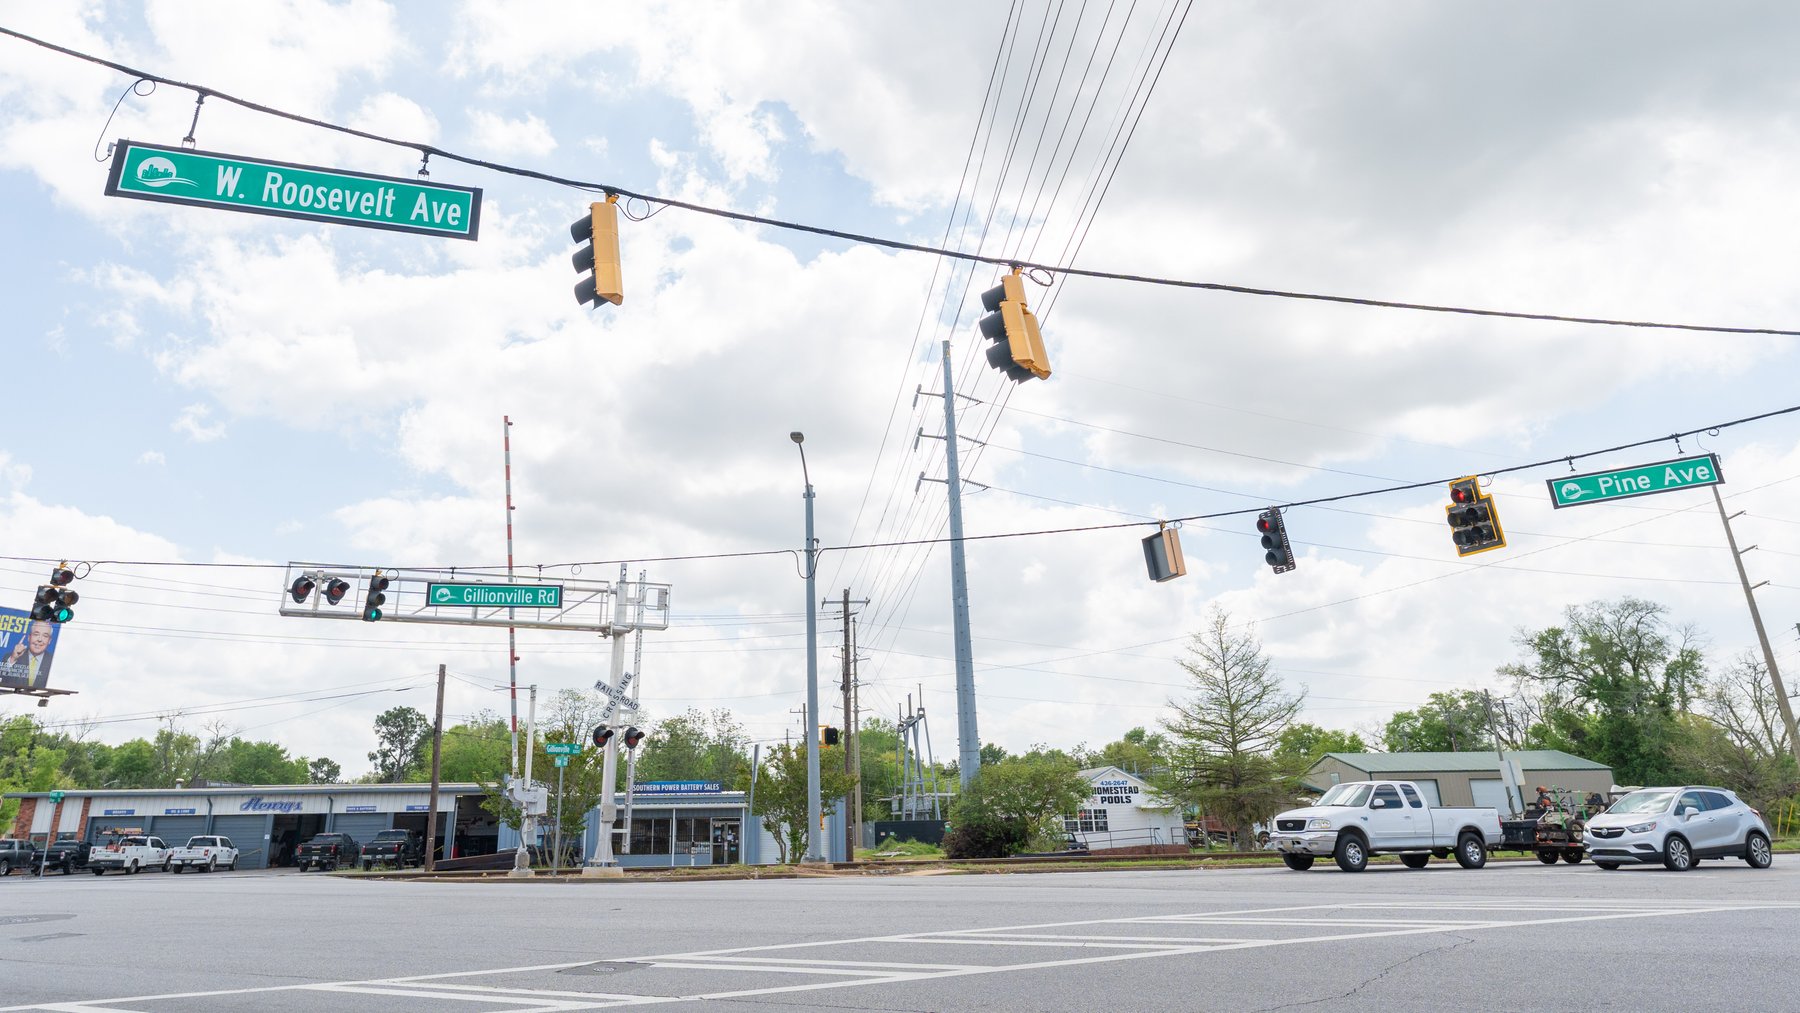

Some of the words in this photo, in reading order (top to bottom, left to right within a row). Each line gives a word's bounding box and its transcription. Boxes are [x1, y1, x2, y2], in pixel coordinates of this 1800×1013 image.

[216, 165, 245, 198] W.
[261, 172, 396, 218] Roosevelt
[410, 192, 461, 226] Ave
[1598, 475, 1651, 495] Pine
[1664, 465, 1711, 486] Ave
[463, 587, 533, 604] Gillionville
[538, 589, 555, 604] Rd
[0, 614, 33, 634] GEST
[602, 673, 632, 719] CROSSING
[661, 783, 680, 791] POWER
[680, 783, 703, 791] BATTERY
[704, 783, 720, 791] SALES
[1101, 796, 1132, 804] POOLS
